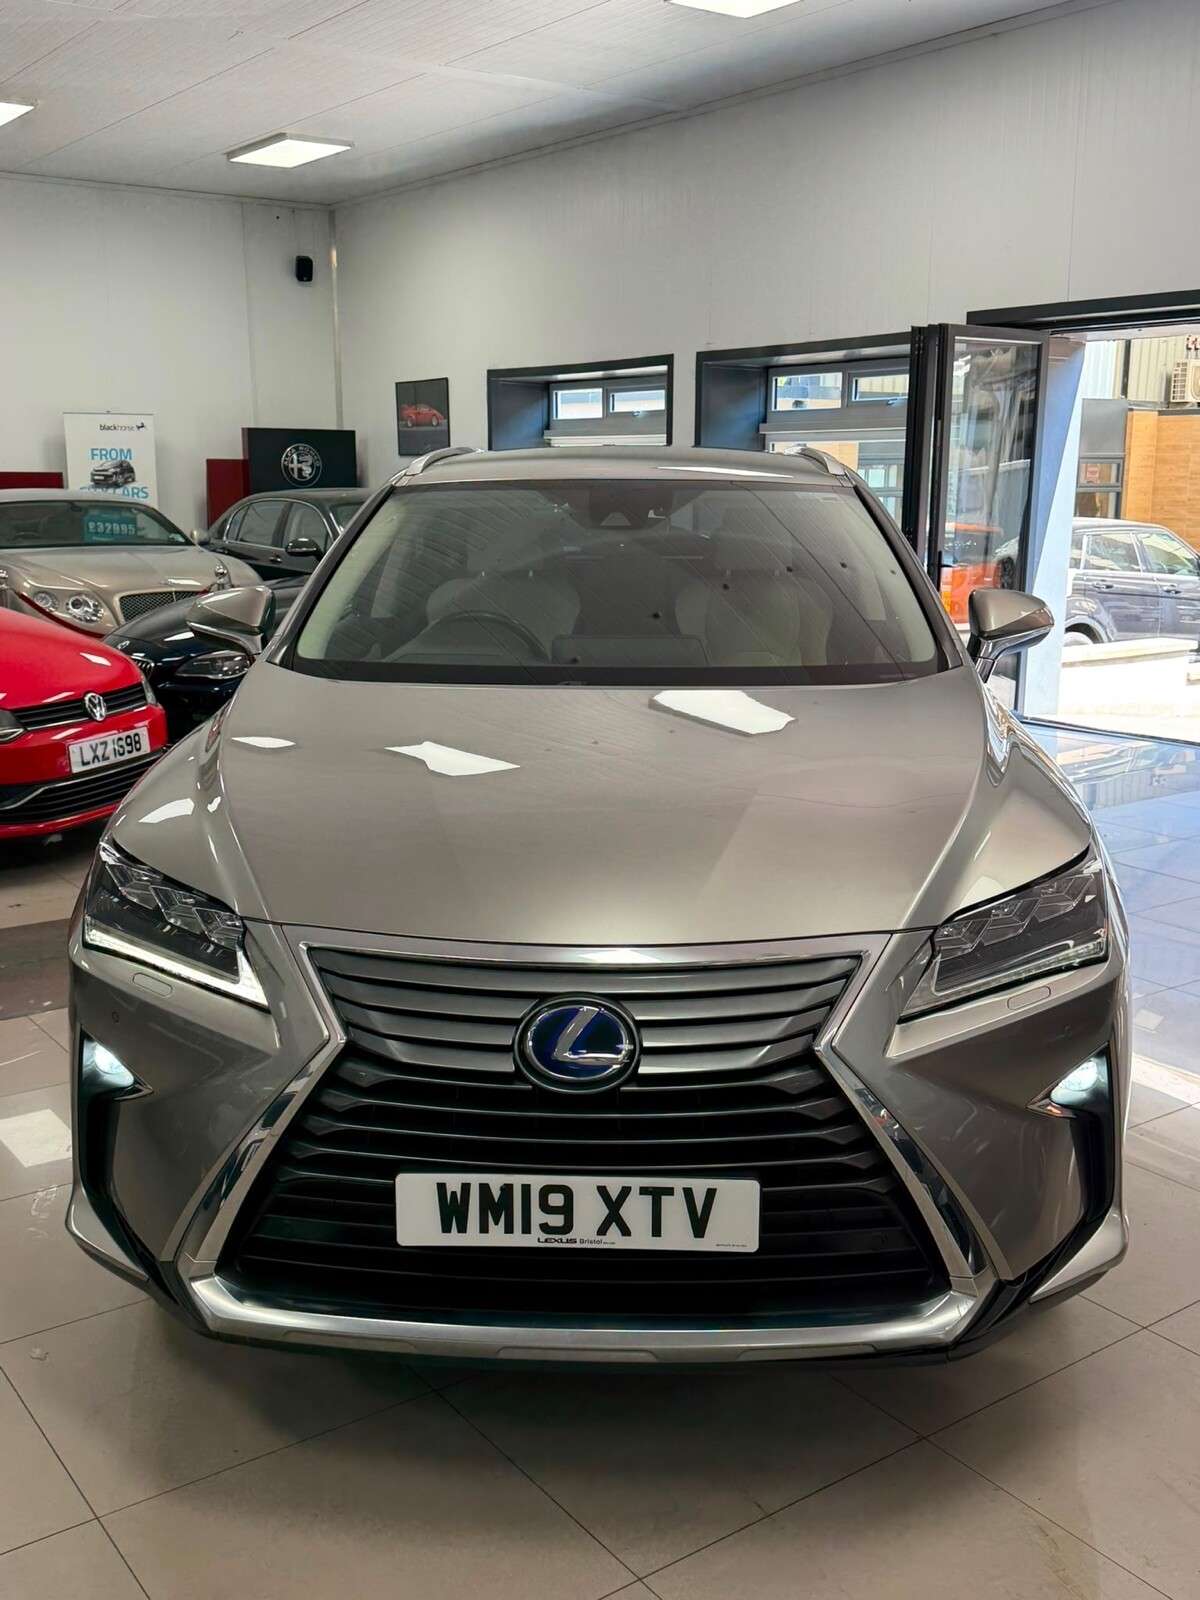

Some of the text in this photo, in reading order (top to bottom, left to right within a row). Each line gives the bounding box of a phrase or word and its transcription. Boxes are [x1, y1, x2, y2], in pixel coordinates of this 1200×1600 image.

[90, 447, 132, 461] FROM
[80, 741, 110, 767] LXZ
[436, 1182, 718, 1239] WM19 XTV
[537, 1237, 577, 1245] LEXUS
